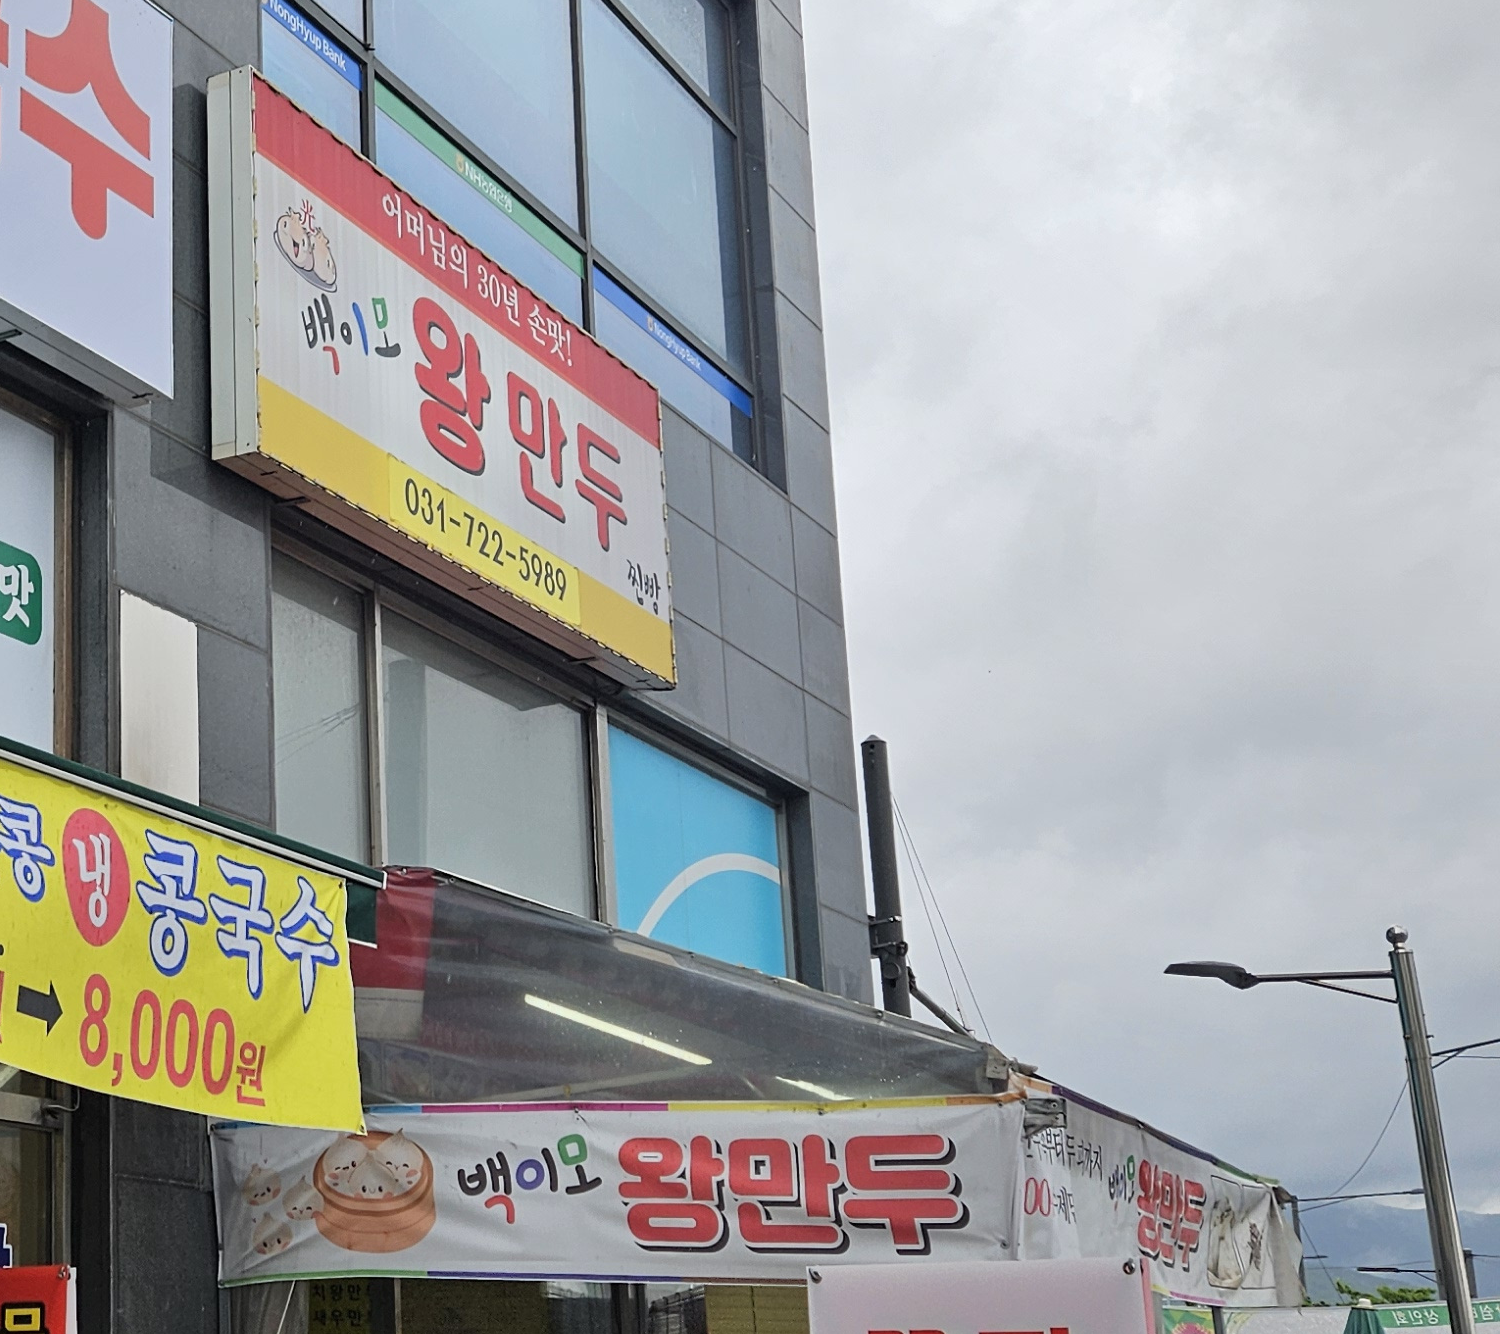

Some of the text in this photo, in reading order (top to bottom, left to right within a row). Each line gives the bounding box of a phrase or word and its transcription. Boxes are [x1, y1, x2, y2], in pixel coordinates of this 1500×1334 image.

[322, 40, 347, 72] Bank
[383, 193, 573, 367] 어머님의 30년 손맛!
[301, 293, 629, 551] 백이모 왕만두
[404, 477, 568, 602] 031-722-5989
[76, 833, 113, 929] 냉
[137, 829, 340, 1013] 콩국수
[79, 973, 267, 1107] 8,000원
[457, 1133, 603, 1224] 백이모
[617, 1132, 969, 1255] 왕만두
[1137, 1159, 1207, 1272] 왕만두
